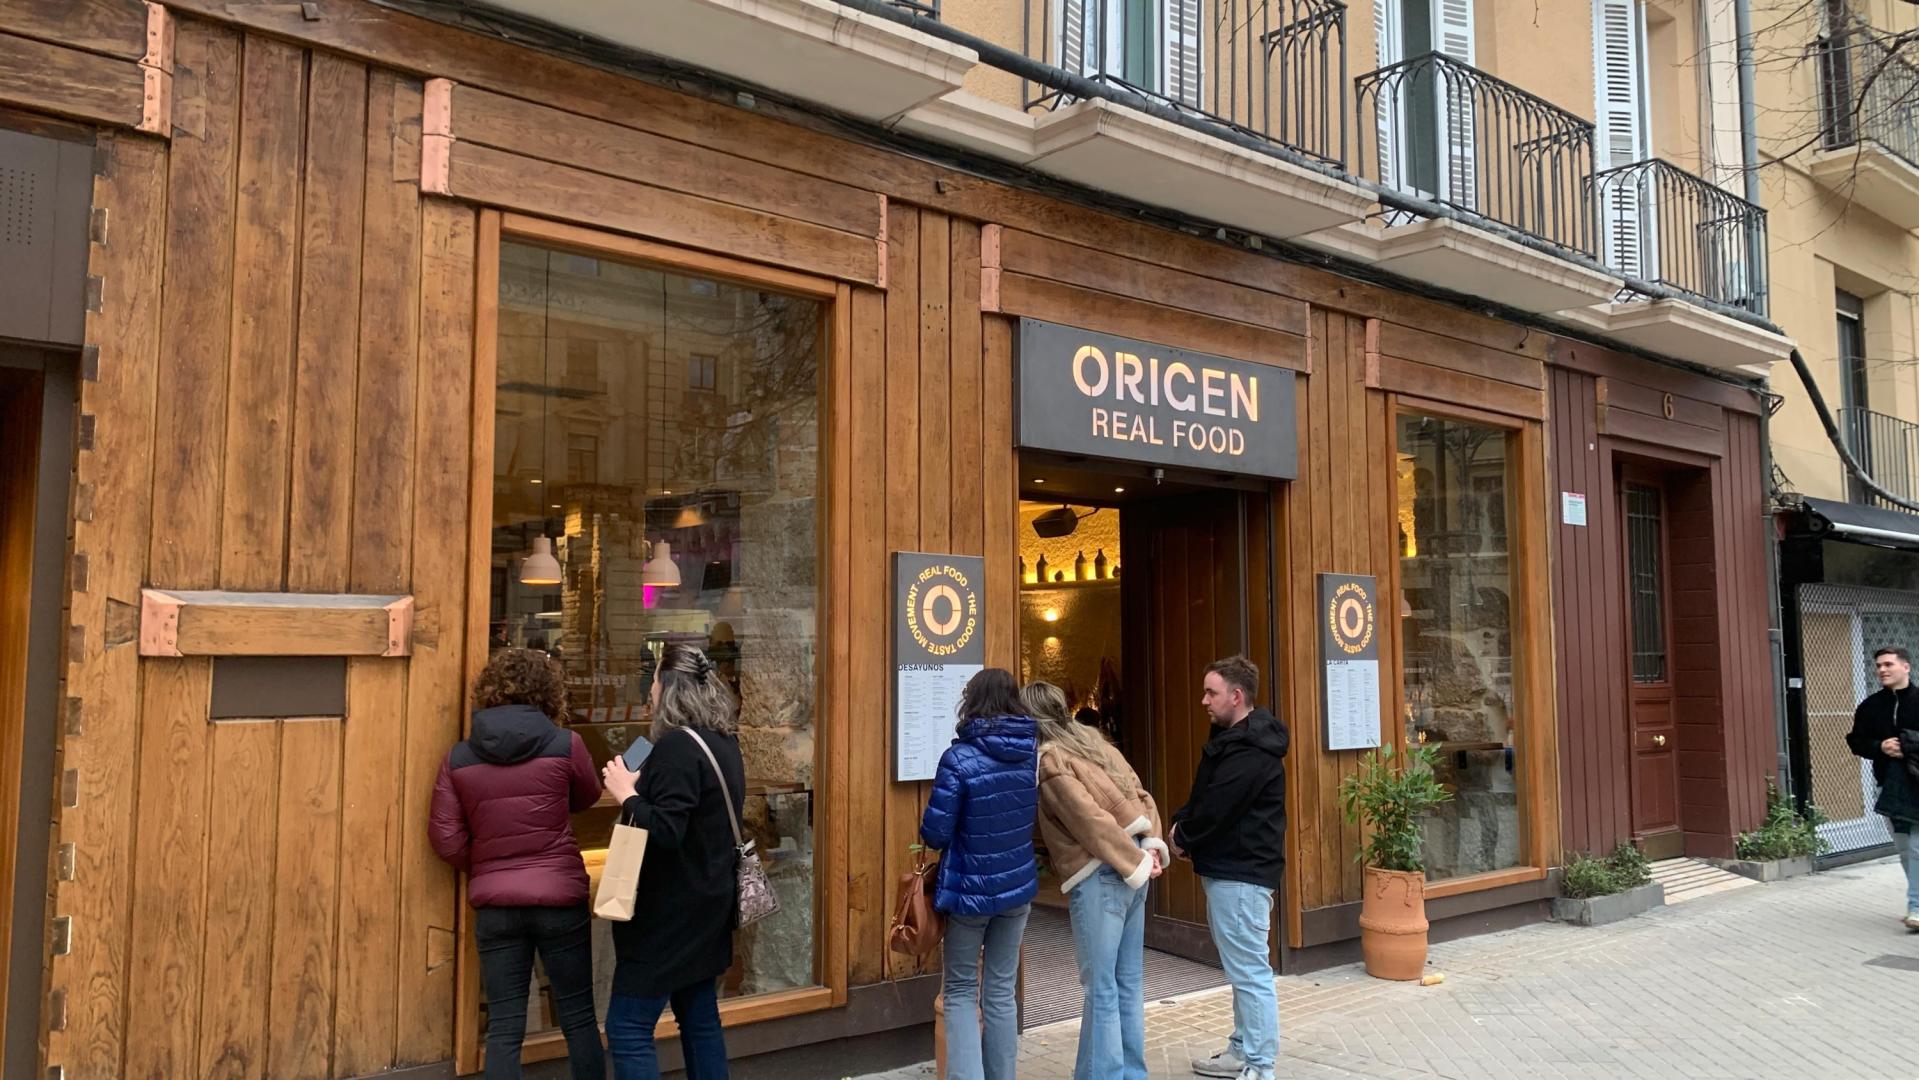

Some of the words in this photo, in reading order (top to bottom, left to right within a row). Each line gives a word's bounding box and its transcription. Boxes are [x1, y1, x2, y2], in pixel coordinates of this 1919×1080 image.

[1072, 345, 1258, 422] ORIGEN
[1664, 393, 1674, 420] 6
[1092, 407, 1164, 445] REAL
[1173, 420, 1245, 456] FOOD
[919, 565, 942, 583] REAL
[943, 565, 968, 587] FOOD
[1336, 583, 1351, 597] REAL
[1351, 583, 1367, 600] FOOD
[906, 583, 928, 648] MOVEMENT
[967, 592, 977, 616] THE
[1366, 603, 1374, 622] THE
[956, 618, 976, 648] GOOD
[1329, 597, 1344, 648] MOVEMENT
[1360, 623, 1373, 648] GOOD
[927, 642, 957, 656] TASTE
[898, 663, 944, 672] DESAYUNOS
